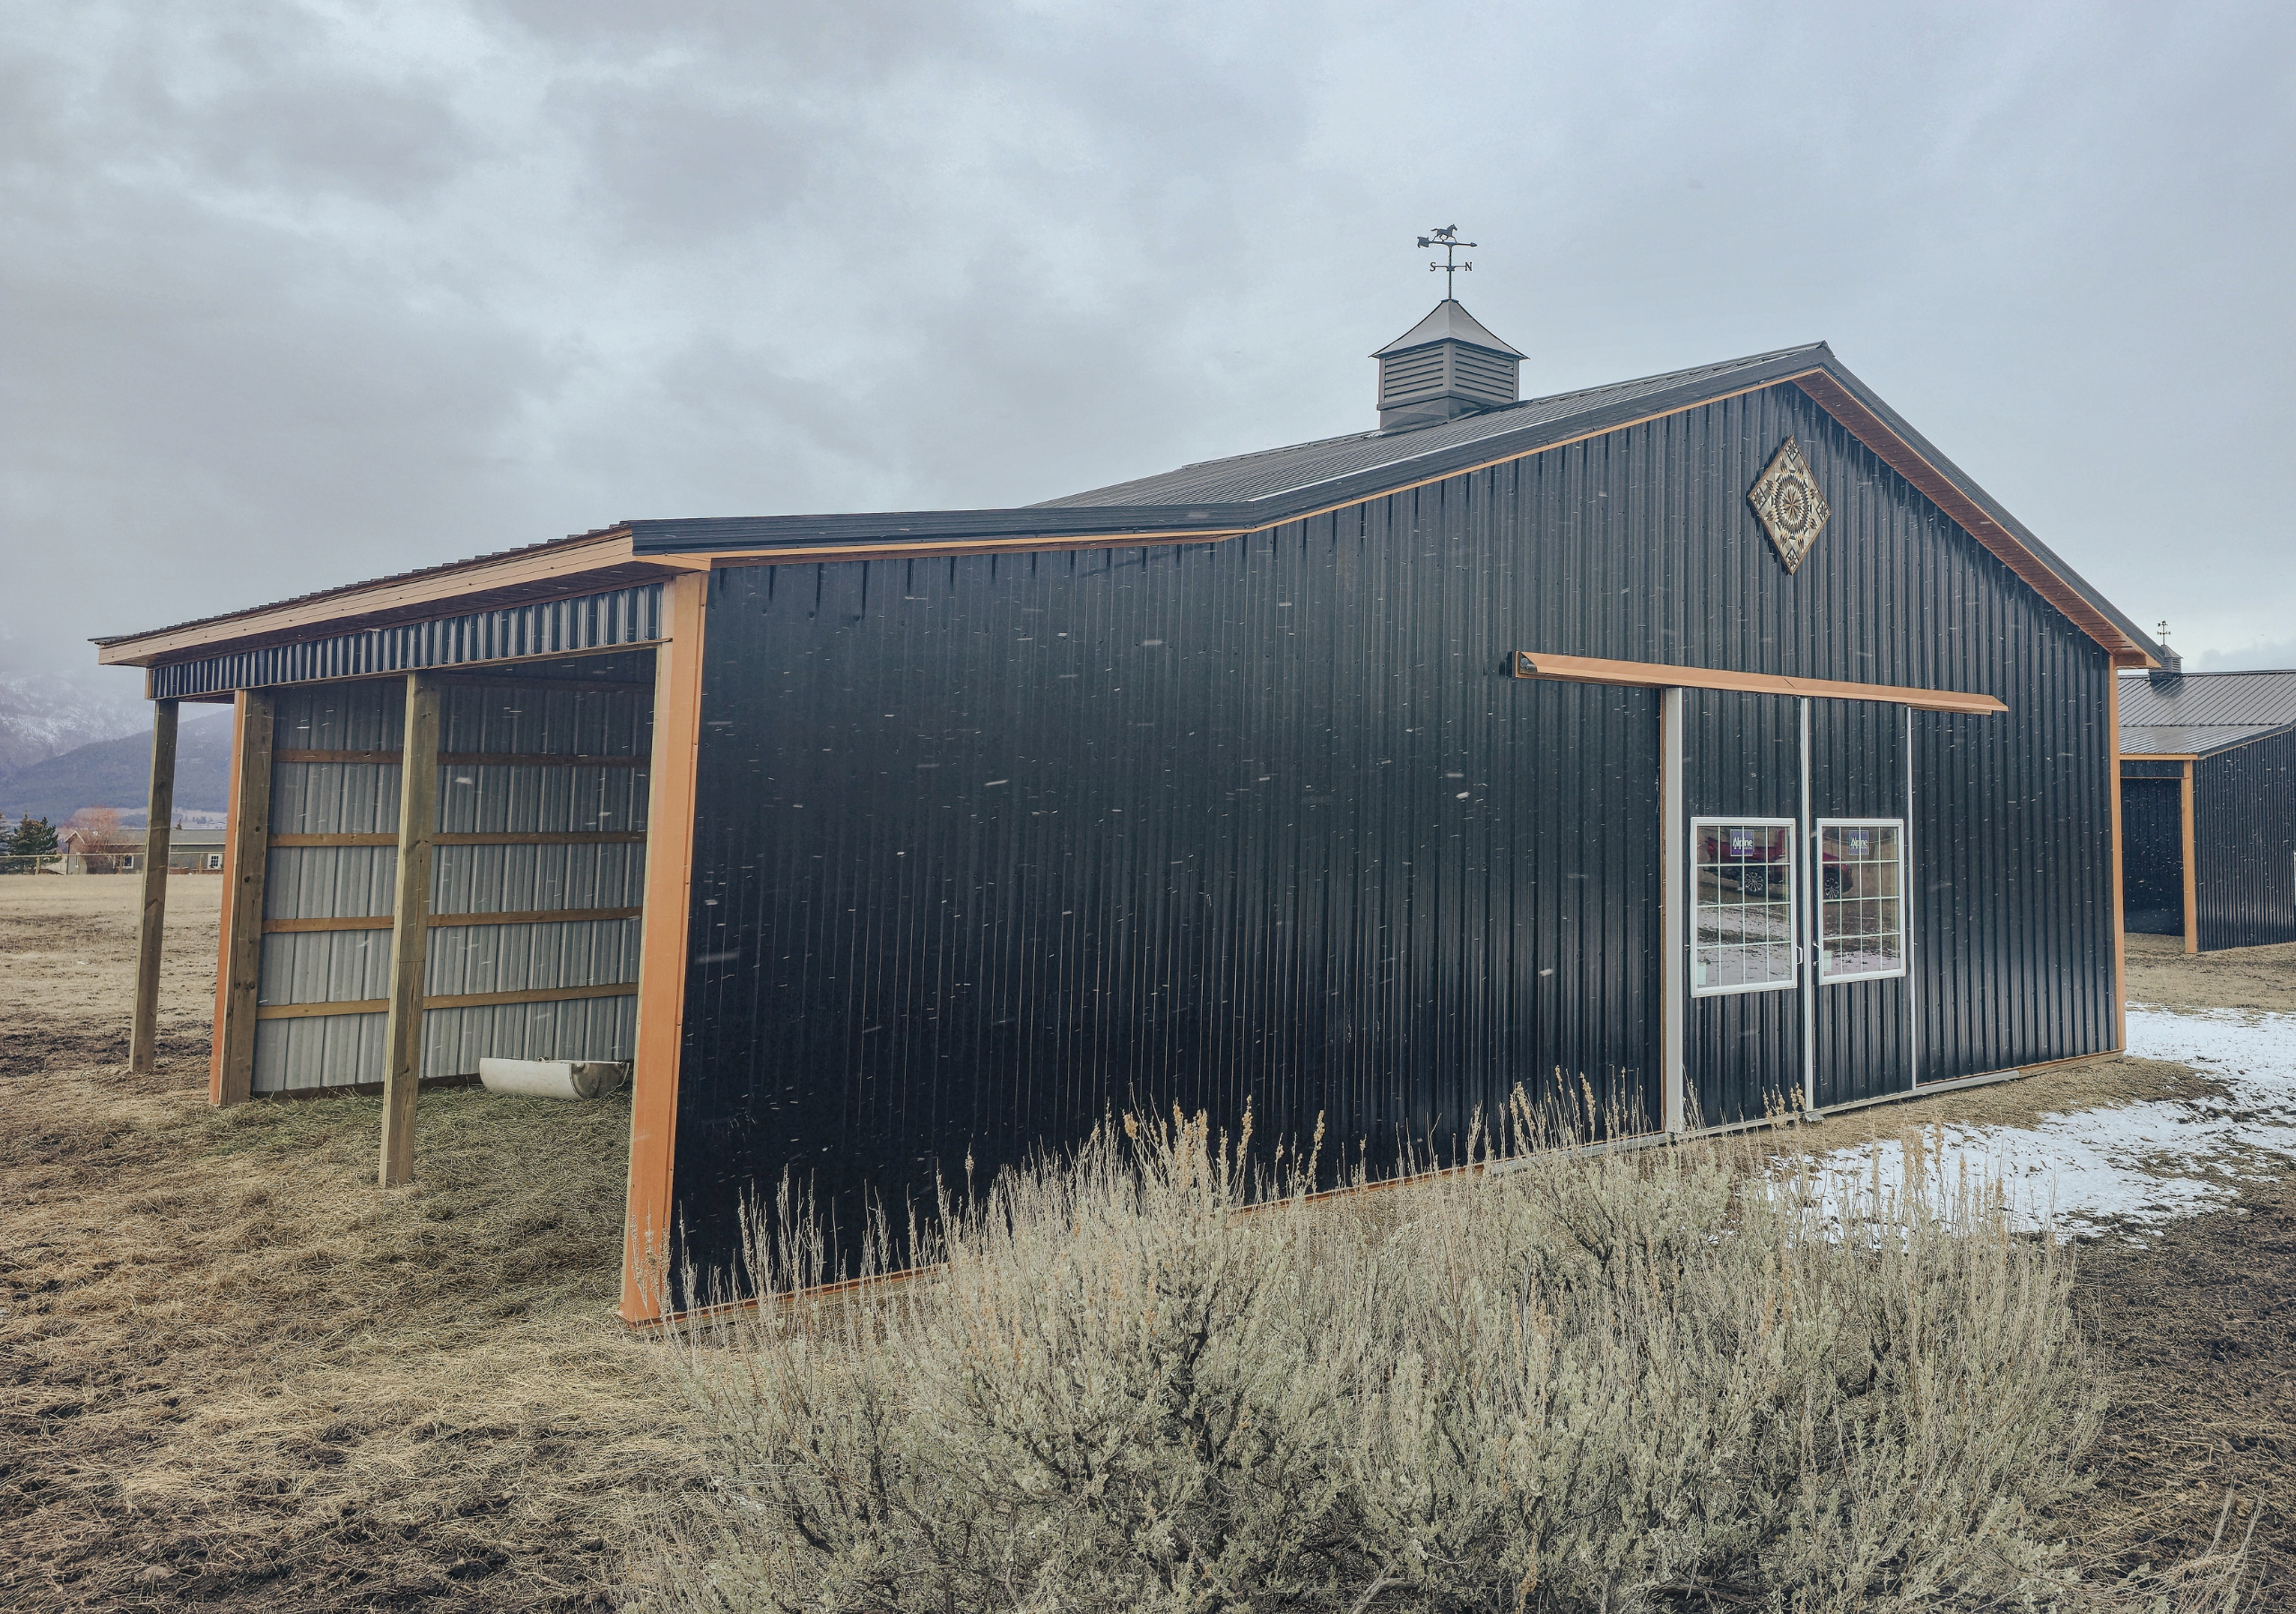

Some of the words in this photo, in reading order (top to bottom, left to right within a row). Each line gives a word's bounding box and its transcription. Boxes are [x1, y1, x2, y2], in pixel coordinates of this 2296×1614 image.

[1430, 261, 1436, 272] S
[1465, 261, 1473, 272] N
[1850, 837, 1868, 850] Alpne
